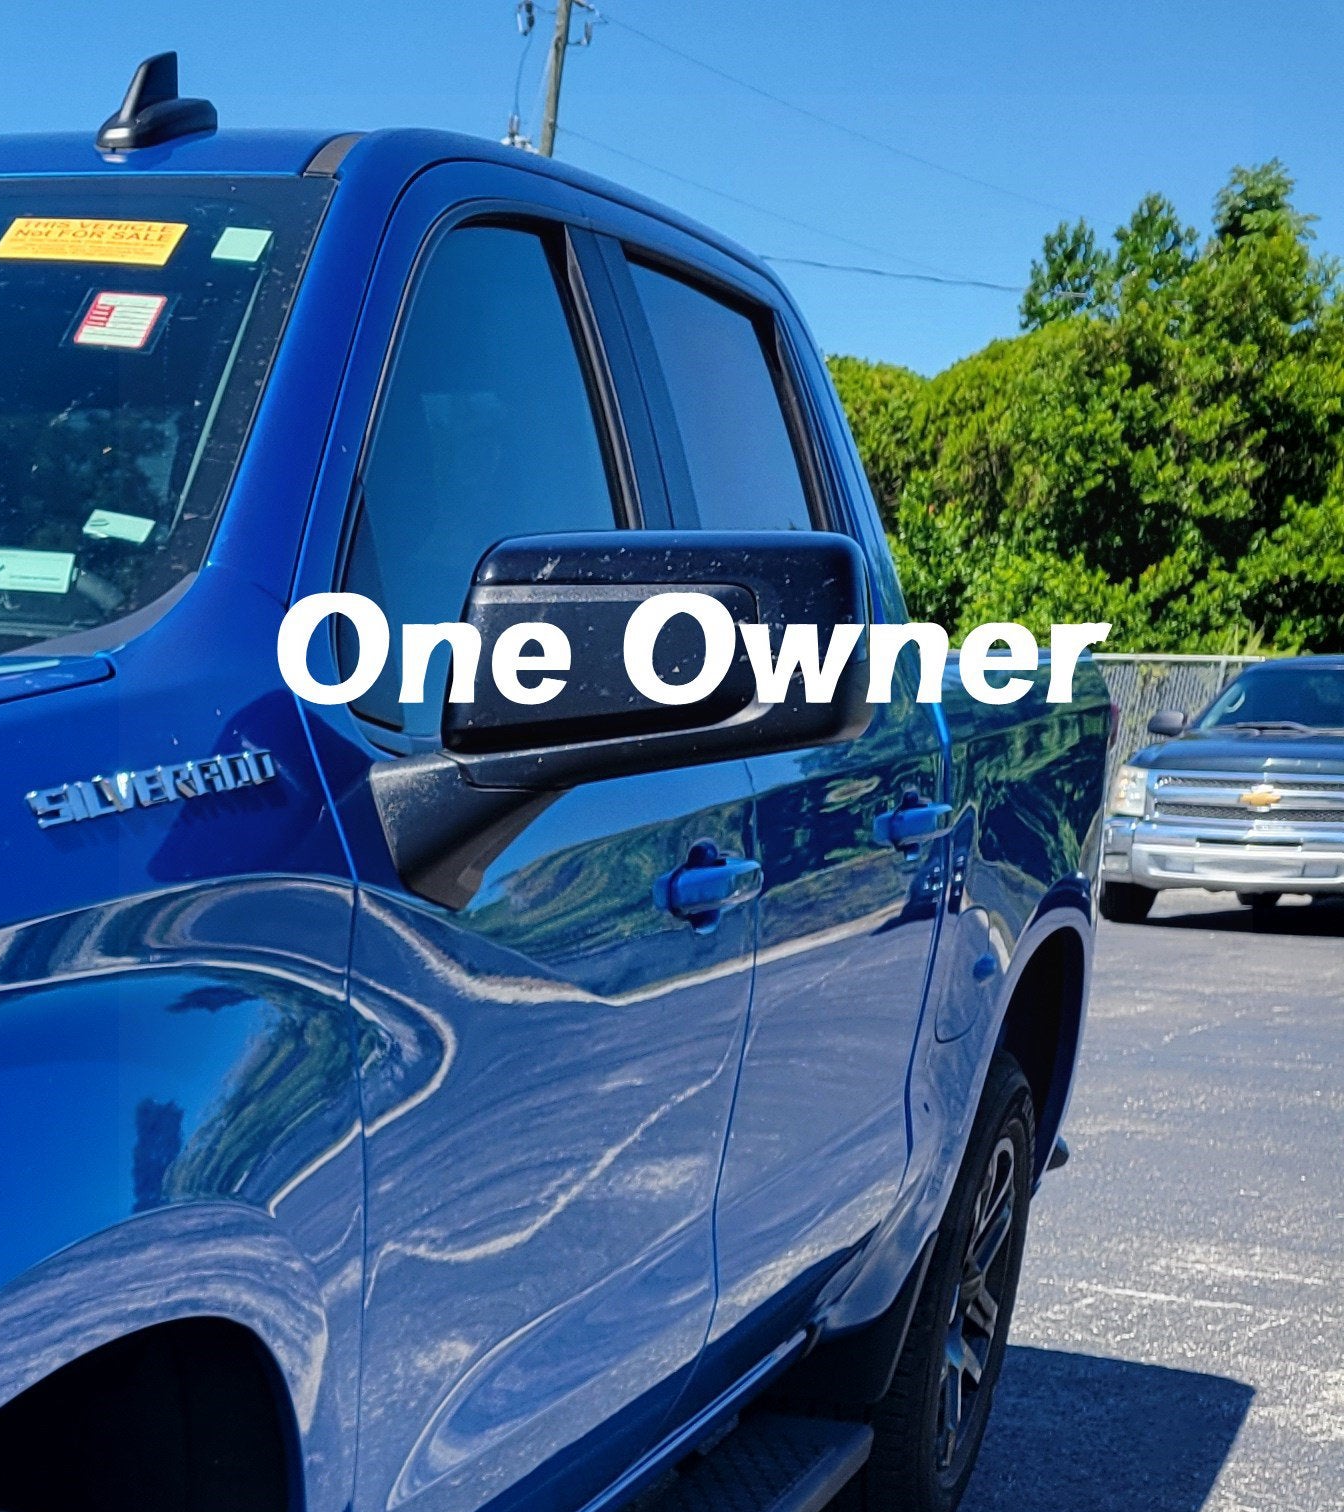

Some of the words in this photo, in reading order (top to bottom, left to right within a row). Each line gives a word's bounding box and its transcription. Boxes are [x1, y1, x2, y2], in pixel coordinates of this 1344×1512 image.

[21, 221, 71, 229] THIS
[80, 222, 175, 233] VEHICLE
[57, 229, 105, 239] FOR
[111, 231, 172, 242] SALE
[24, 748, 277, 829] SILVERADO
